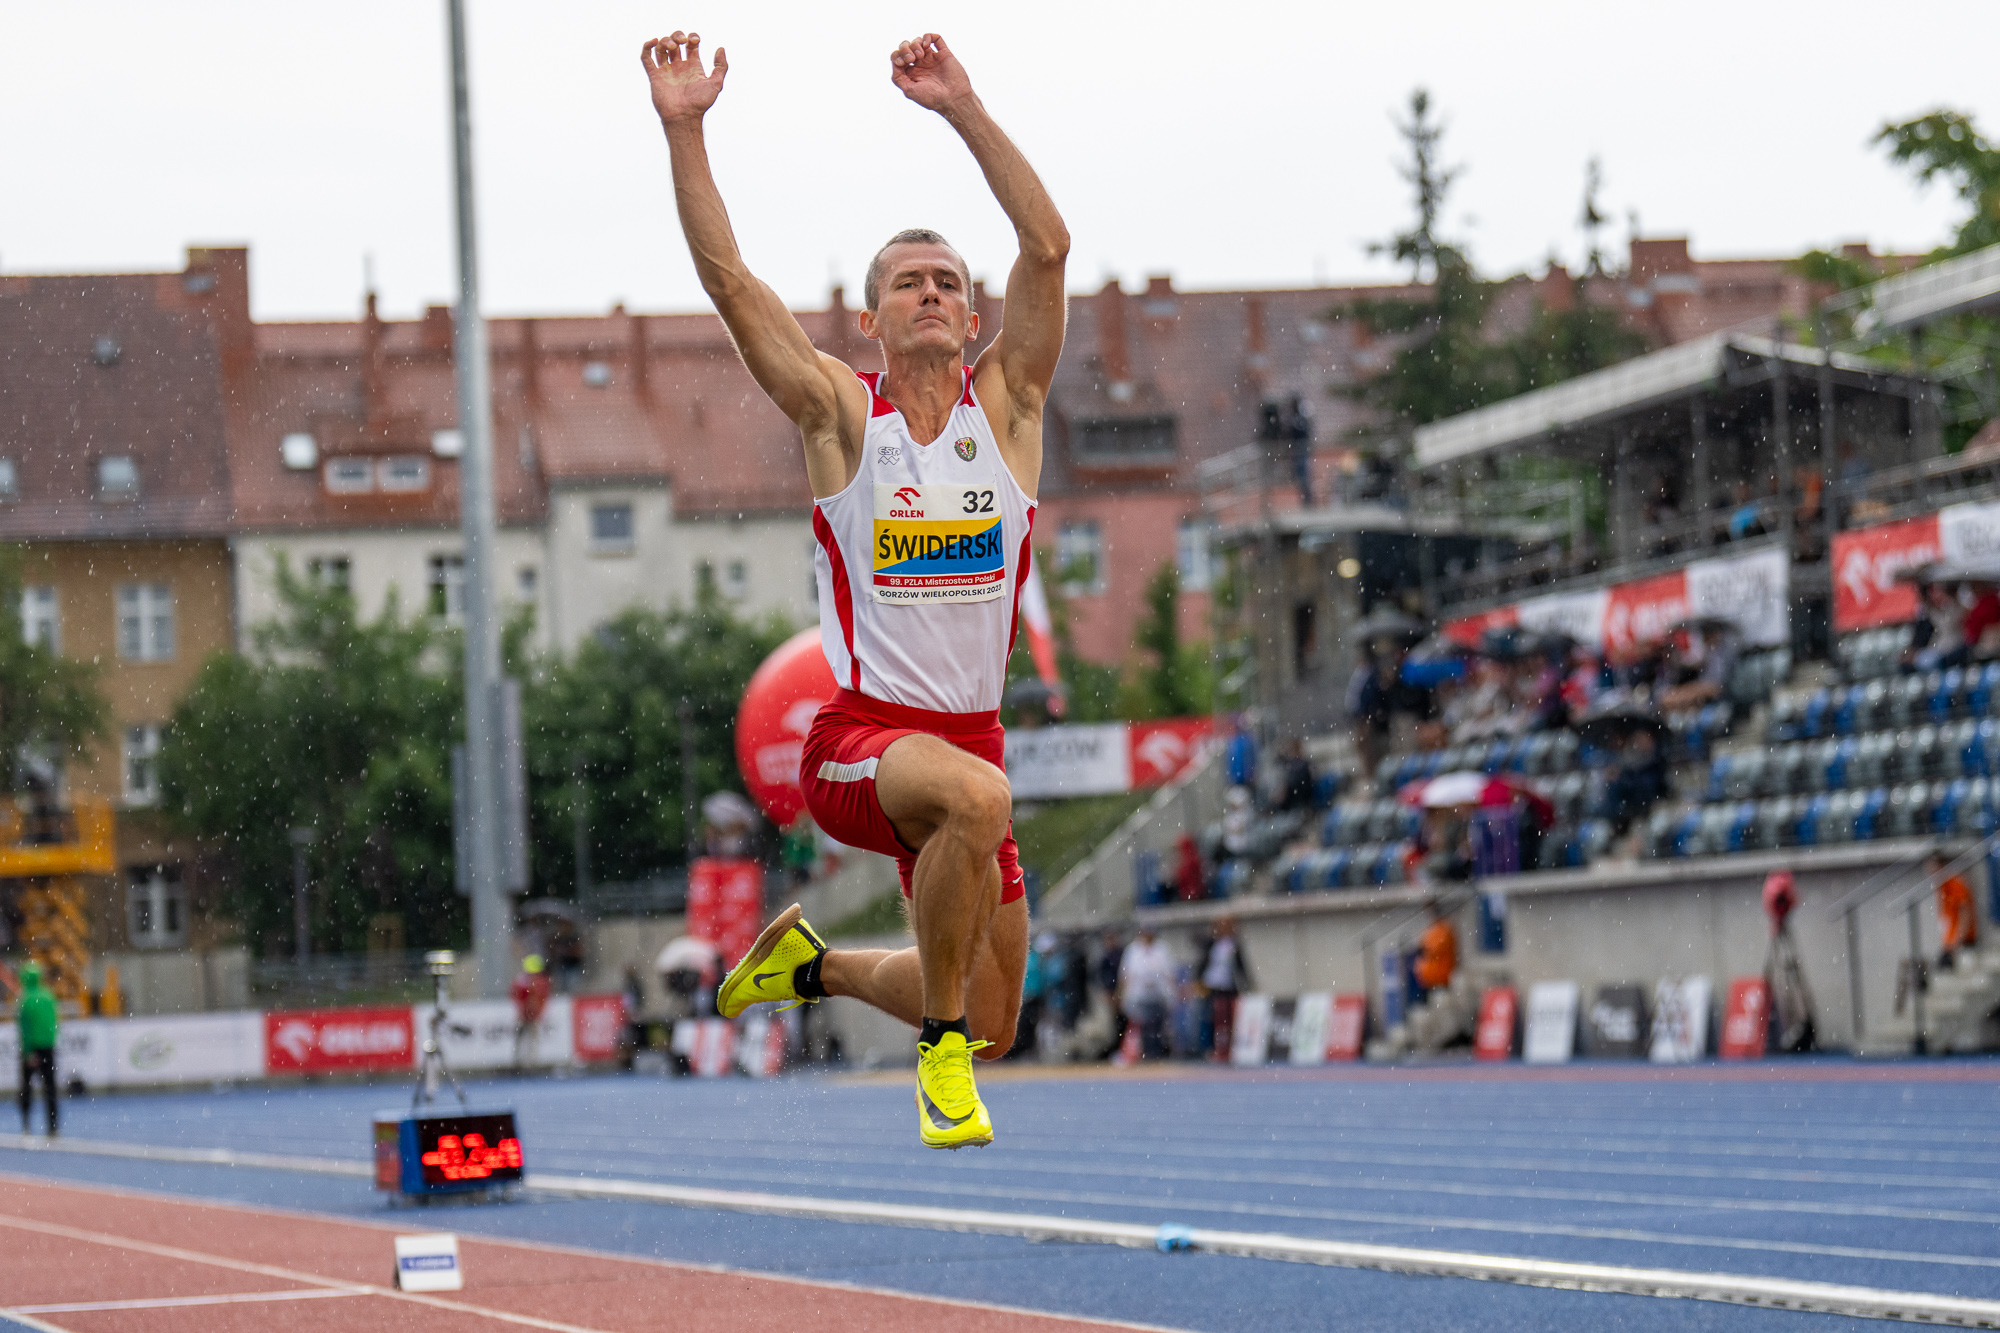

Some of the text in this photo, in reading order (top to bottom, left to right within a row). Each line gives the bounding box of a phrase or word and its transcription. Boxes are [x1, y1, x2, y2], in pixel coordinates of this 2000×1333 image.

[962, 490, 994, 513] 32
[889, 509, 924, 518] ORLEN
[878, 528, 1002, 561] ŚWIDERSKI
[889, 573, 996, 586] 99. PZLA Mistrzostwa Polski
[879, 584, 1002, 599] GORZÓW WIELKOPOLSKI 2023
